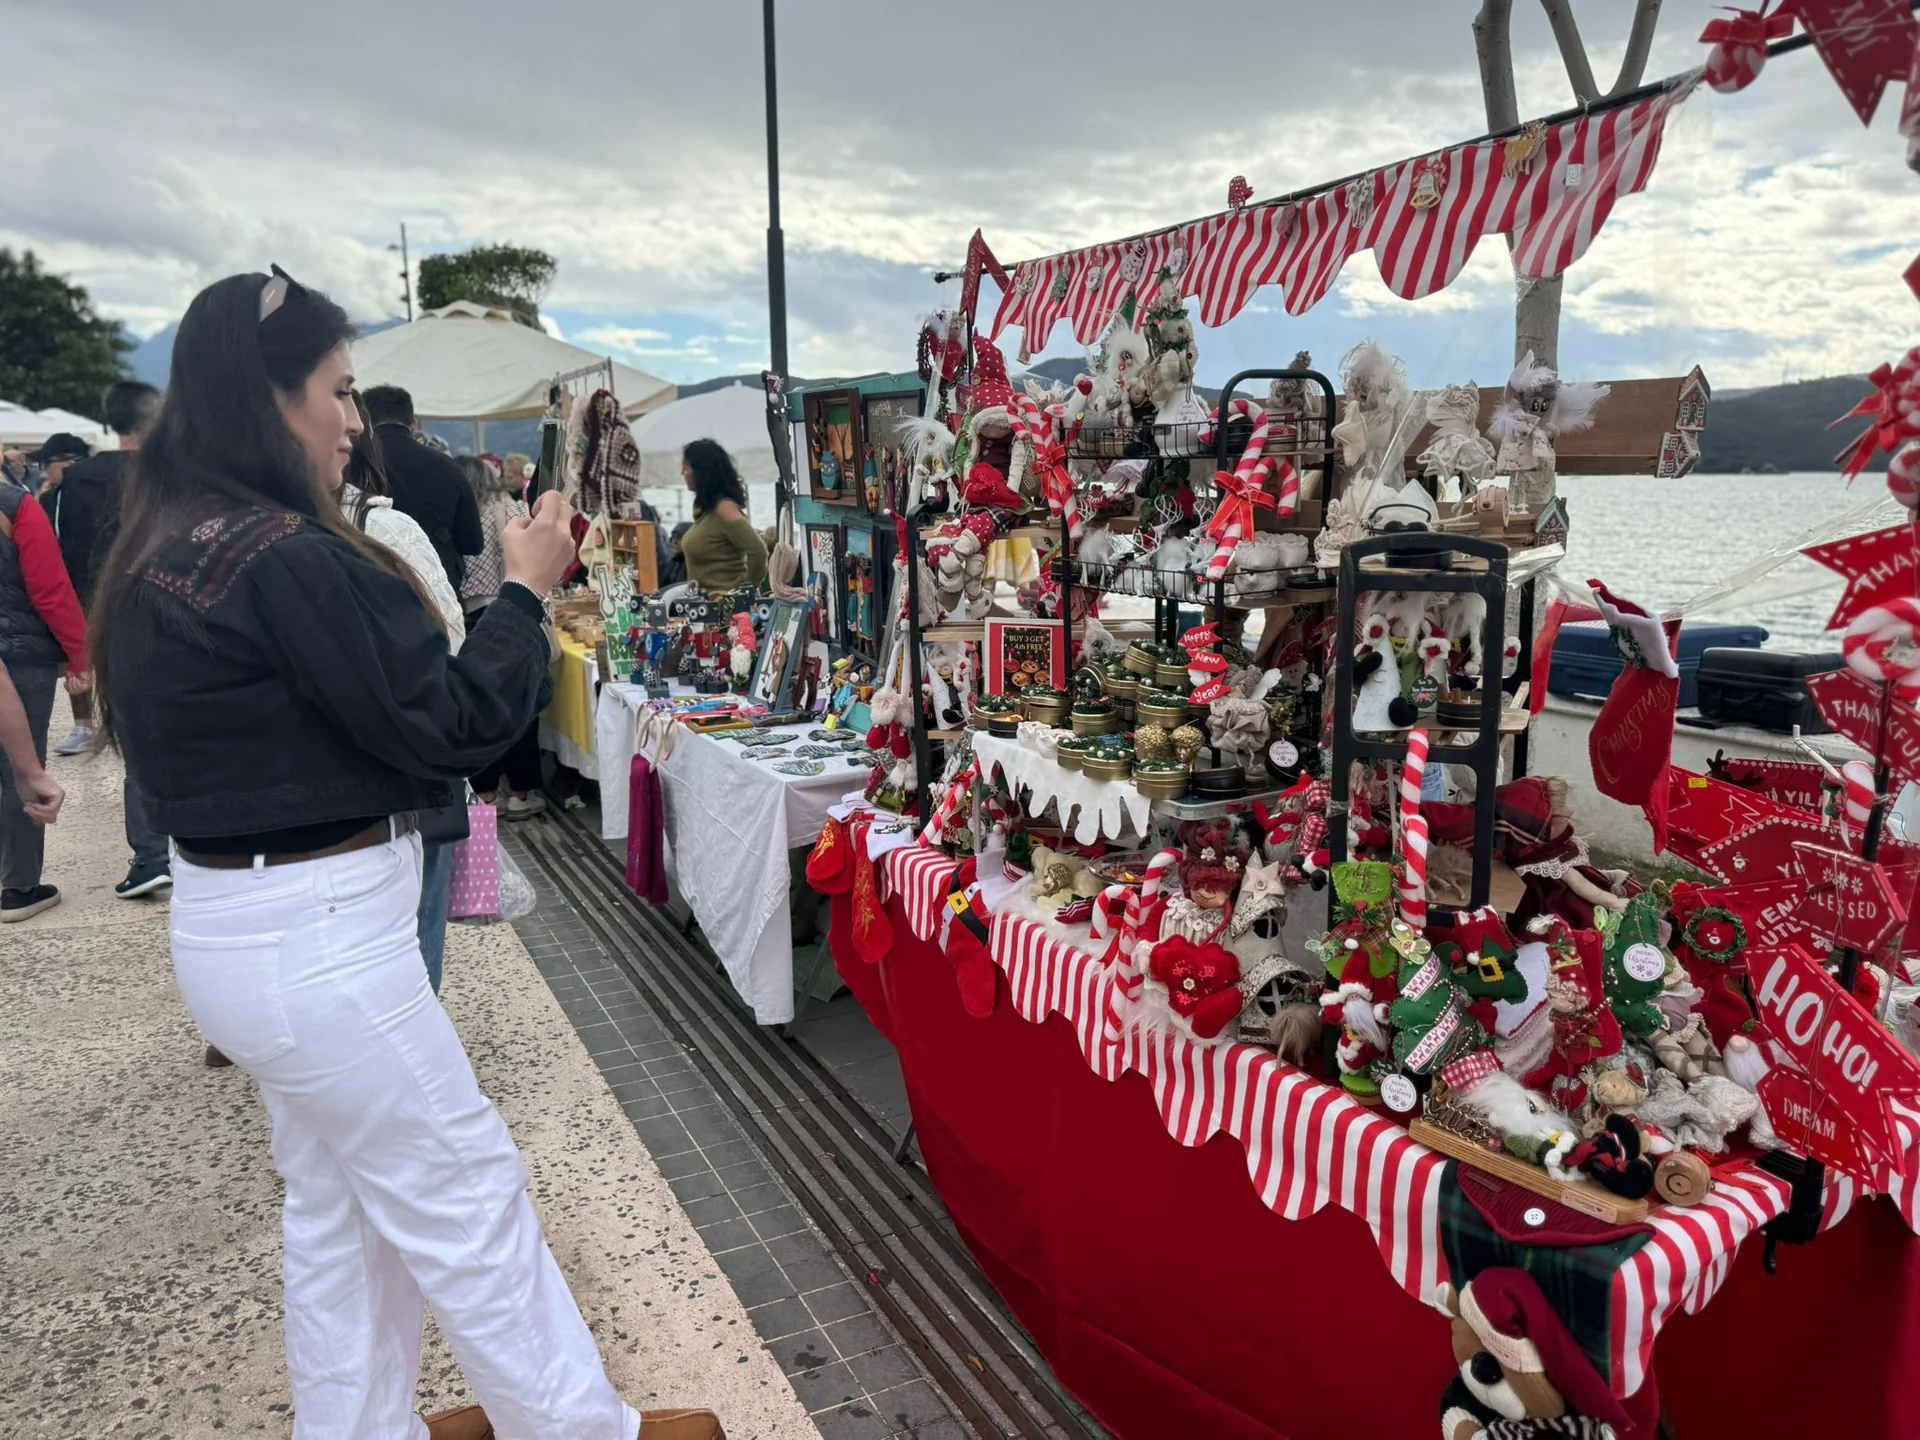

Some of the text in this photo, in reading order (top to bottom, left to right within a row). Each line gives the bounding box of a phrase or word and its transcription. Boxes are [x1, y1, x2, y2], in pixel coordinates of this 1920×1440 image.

[1030, 635, 1045, 643] GET
[1026, 643, 1044, 651] FREE
[1195, 652, 1220, 664] New
[1758, 955, 1879, 1094] HO HO!
[1783, 1097, 1837, 1141] DREAM
